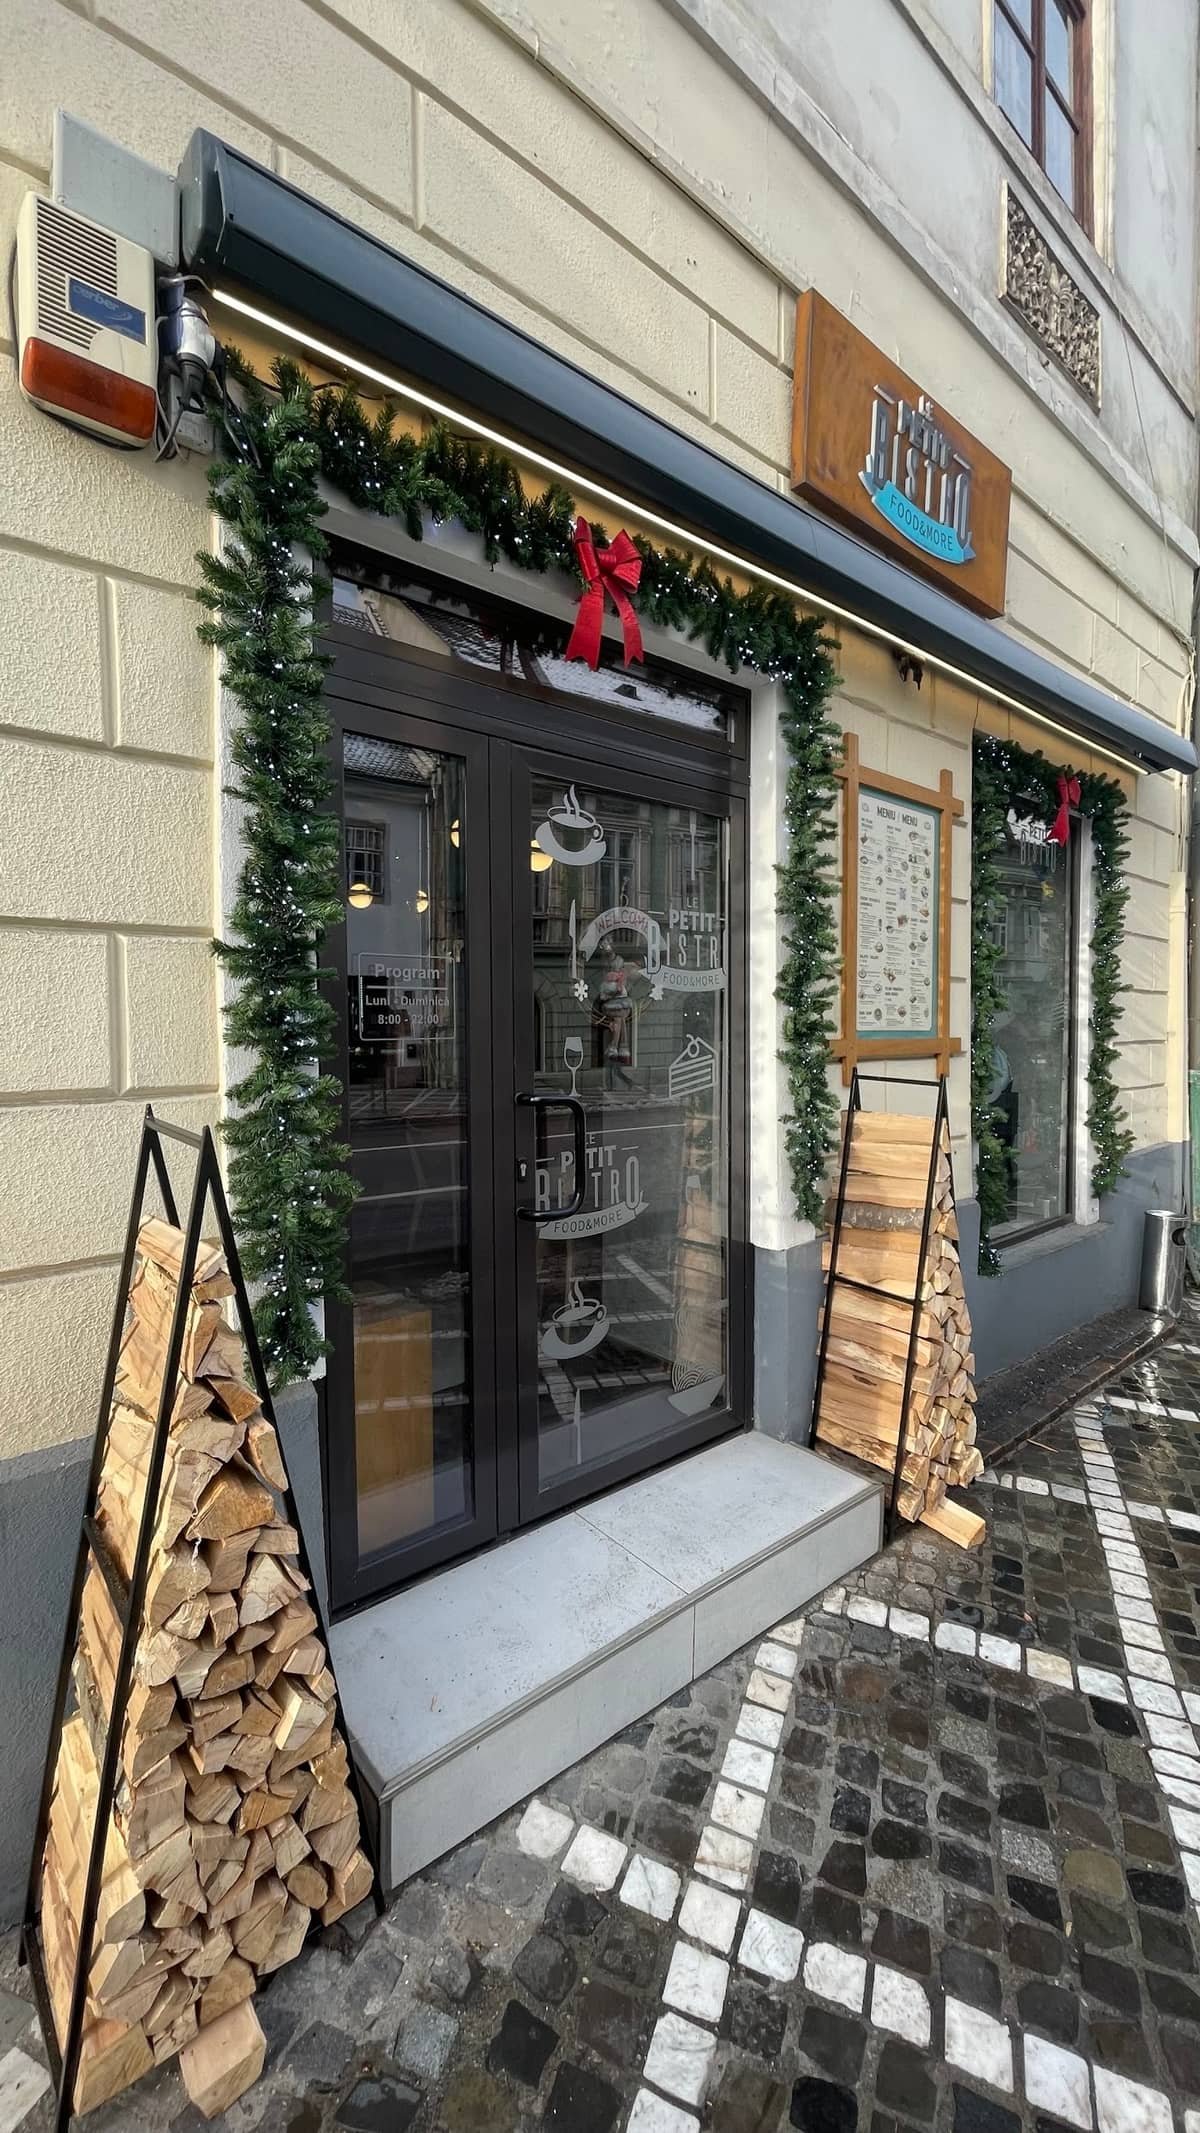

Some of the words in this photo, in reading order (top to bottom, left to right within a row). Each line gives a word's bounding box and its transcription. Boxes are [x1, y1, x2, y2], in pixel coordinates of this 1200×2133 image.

[918, 395, 934, 421] LE
[897, 400, 951, 470] PETIT
[870, 399, 970, 549] BISTRO
[889, 494, 953, 551] FOOD&MORE
[902, 813, 918, 827] MENU
[686, 897, 699, 909] LE
[595, 909, 648, 933] WELCOM
[668, 908, 716, 932] PETIT
[374, 963, 440, 981] Program
[662, 971, 720, 987] FOOD&MORE
[365, 994, 391, 1006] Luni
[377, 1014, 401, 1025] 8:00
[560, 1145, 617, 1173] PTIT
[553, 1209, 623, 1233] FOOD&MORE
